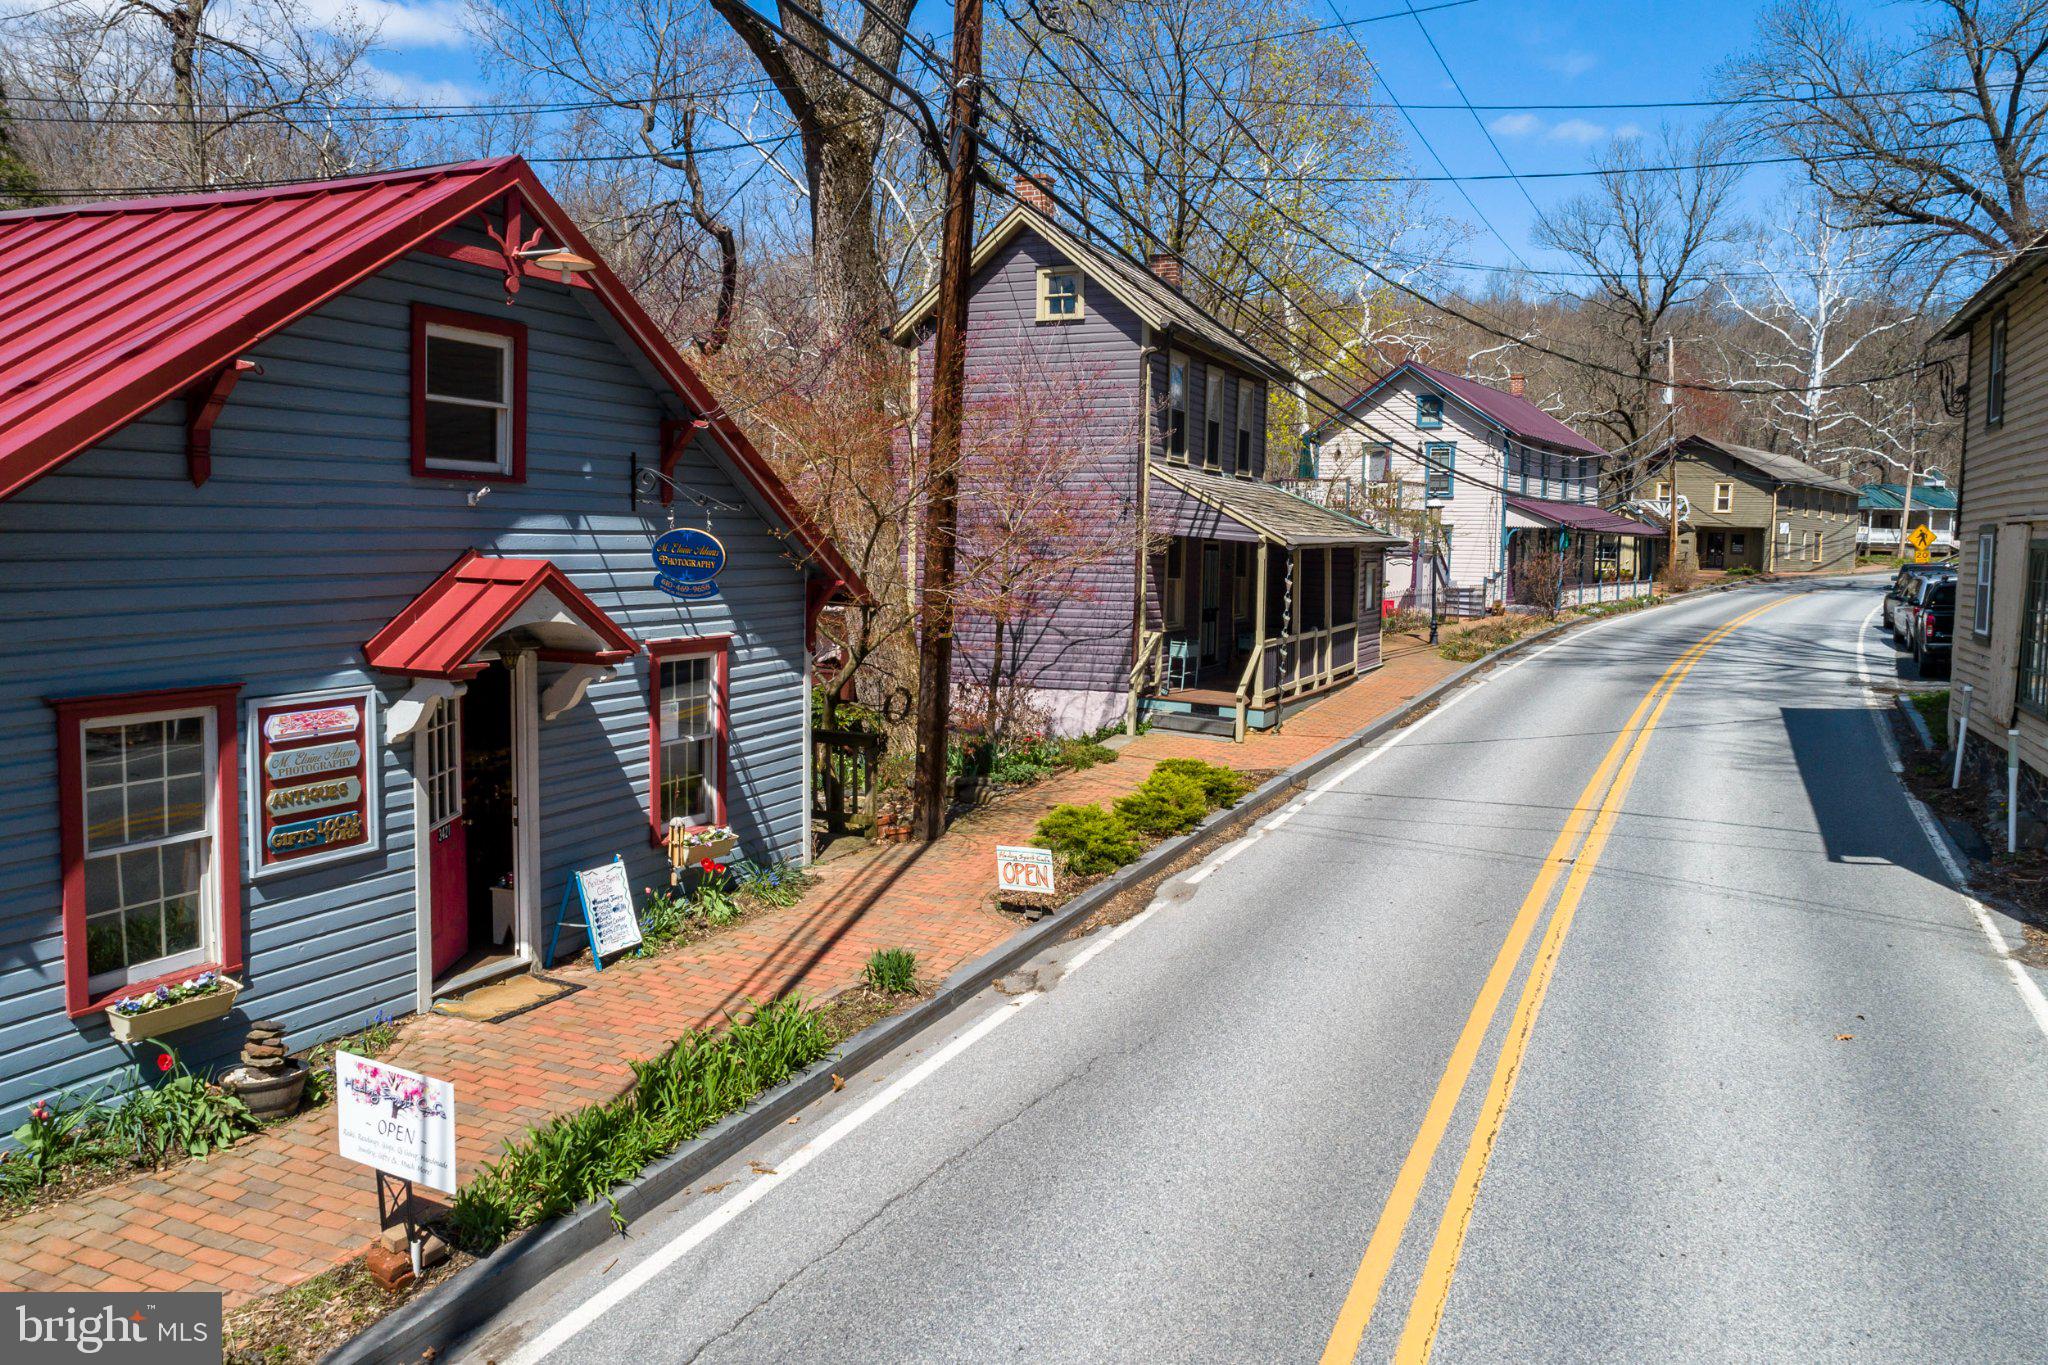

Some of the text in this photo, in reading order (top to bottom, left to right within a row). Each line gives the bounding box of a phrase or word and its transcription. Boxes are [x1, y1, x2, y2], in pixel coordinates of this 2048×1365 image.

[671, 543, 692, 555] Elaine
[693, 545, 720, 557] Adams
[658, 555, 716, 569] PHOTOGRAPHY
[294, 751, 321, 766] Elaine
[324, 746, 356, 761] Adams
[278, 757, 352, 778] PHOTOGRAPHY
[271, 782, 349, 808] ANTIQUES
[317, 813, 361, 833] LOCAL
[438, 824, 451, 842] 3421
[272, 828, 317, 848] GIFTS
[325, 827, 361, 843] LORE
[1003, 862, 1049, 887] OPEN
[378, 1119, 415, 1144] OPEN
[420, 1154, 448, 1169] Handmade
